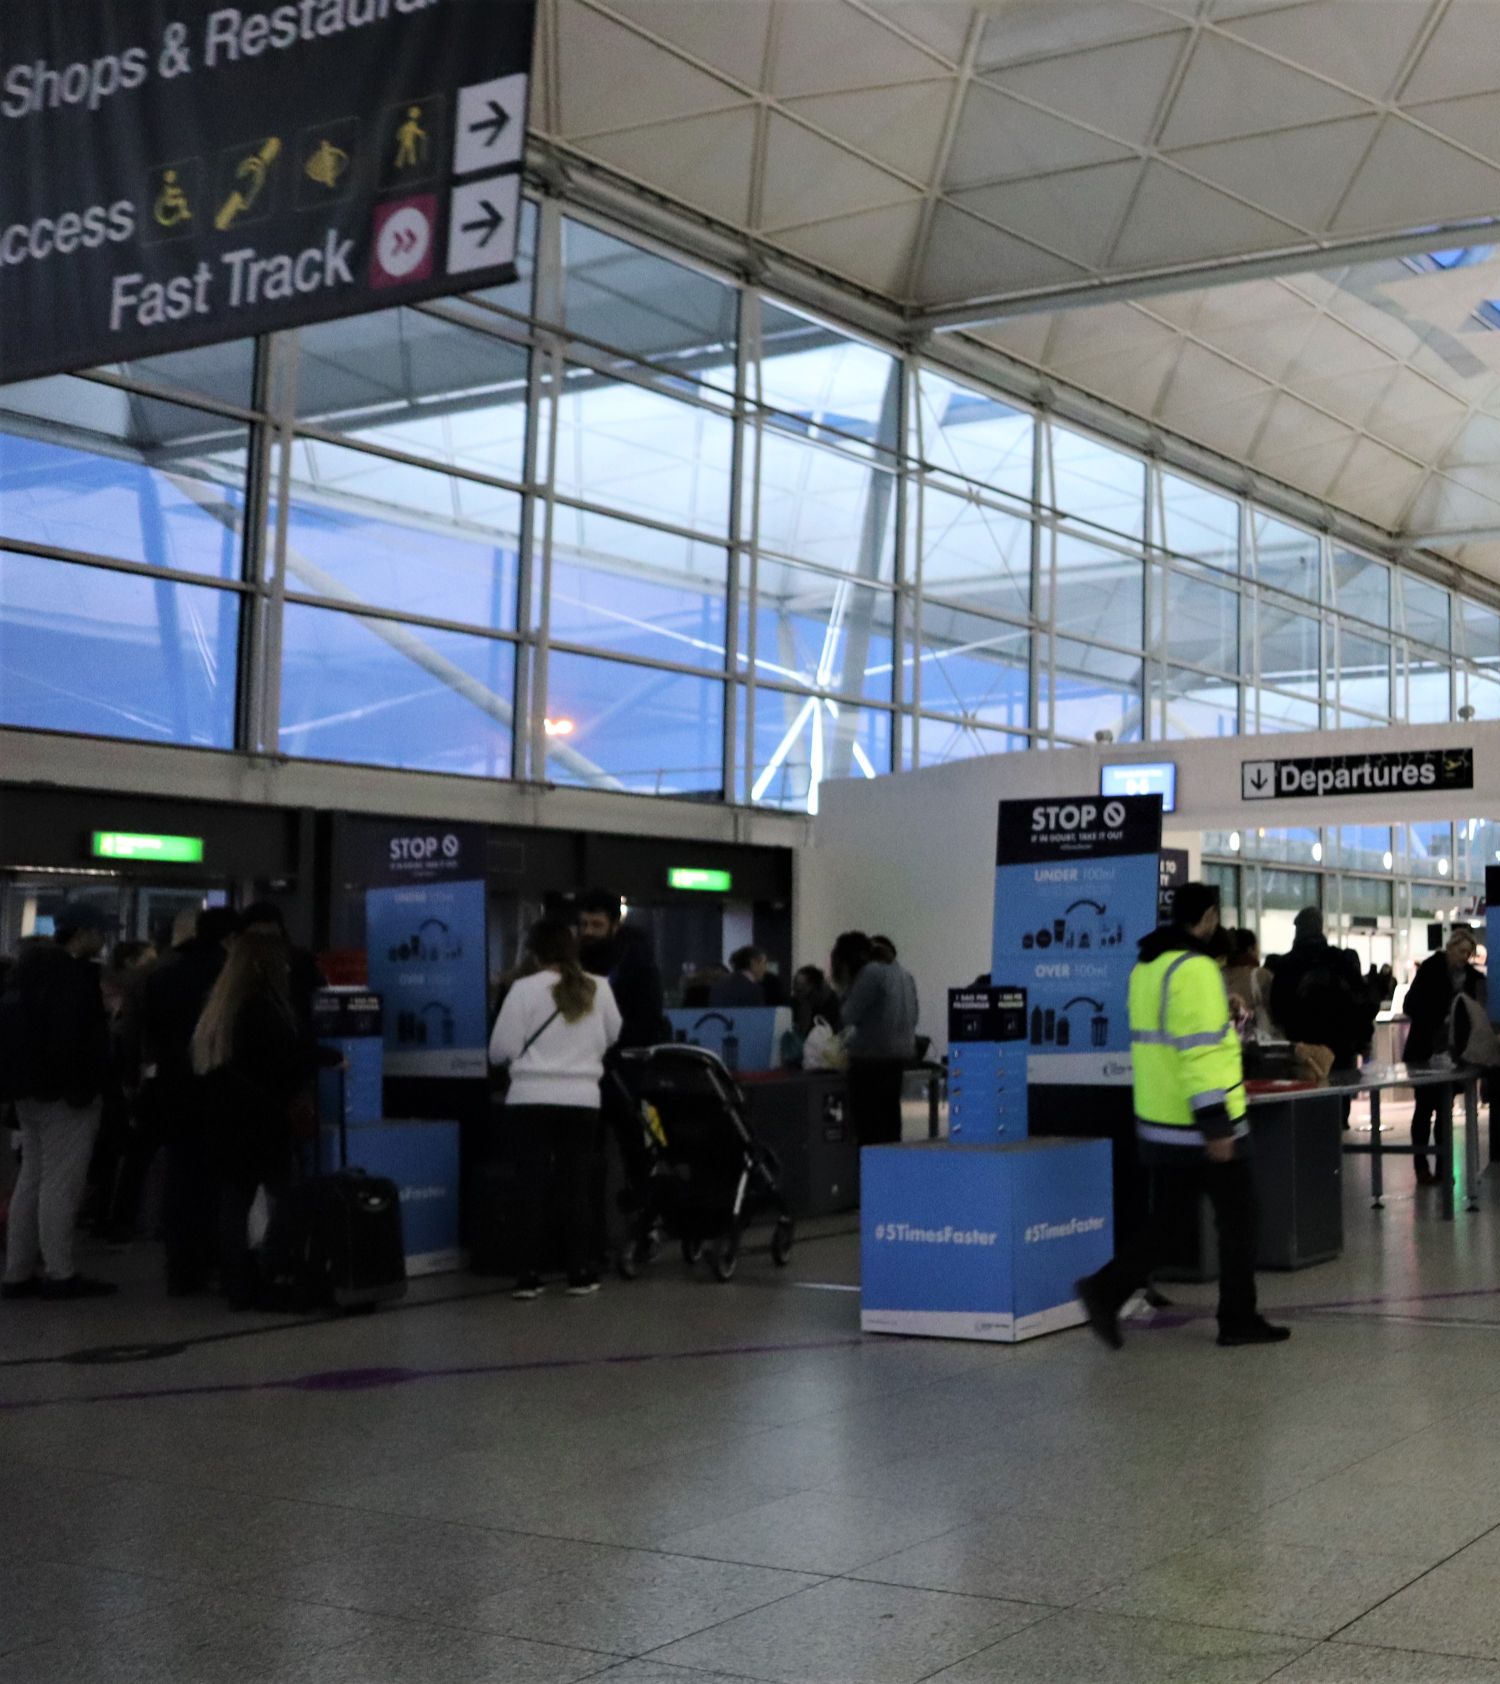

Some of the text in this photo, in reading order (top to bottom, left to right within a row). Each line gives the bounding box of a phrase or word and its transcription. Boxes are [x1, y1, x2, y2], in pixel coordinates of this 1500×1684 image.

[1, 47, 149, 118] Shops
[158, 22, 192, 79] &
[0, 200, 136, 266] ccess
[109, 228, 354, 331] Fast Track
[1280, 762, 1436, 796] Departures
[1031, 805, 1097, 832] STOP
[389, 836, 438, 860] STOP
[1034, 867, 1079, 882] UNDER
[1035, 963, 1071, 978] OVER
[874, 1223, 998, 1246] #5TimesFaster
[1024, 1216, 1105, 1243] #5TimesFaster
